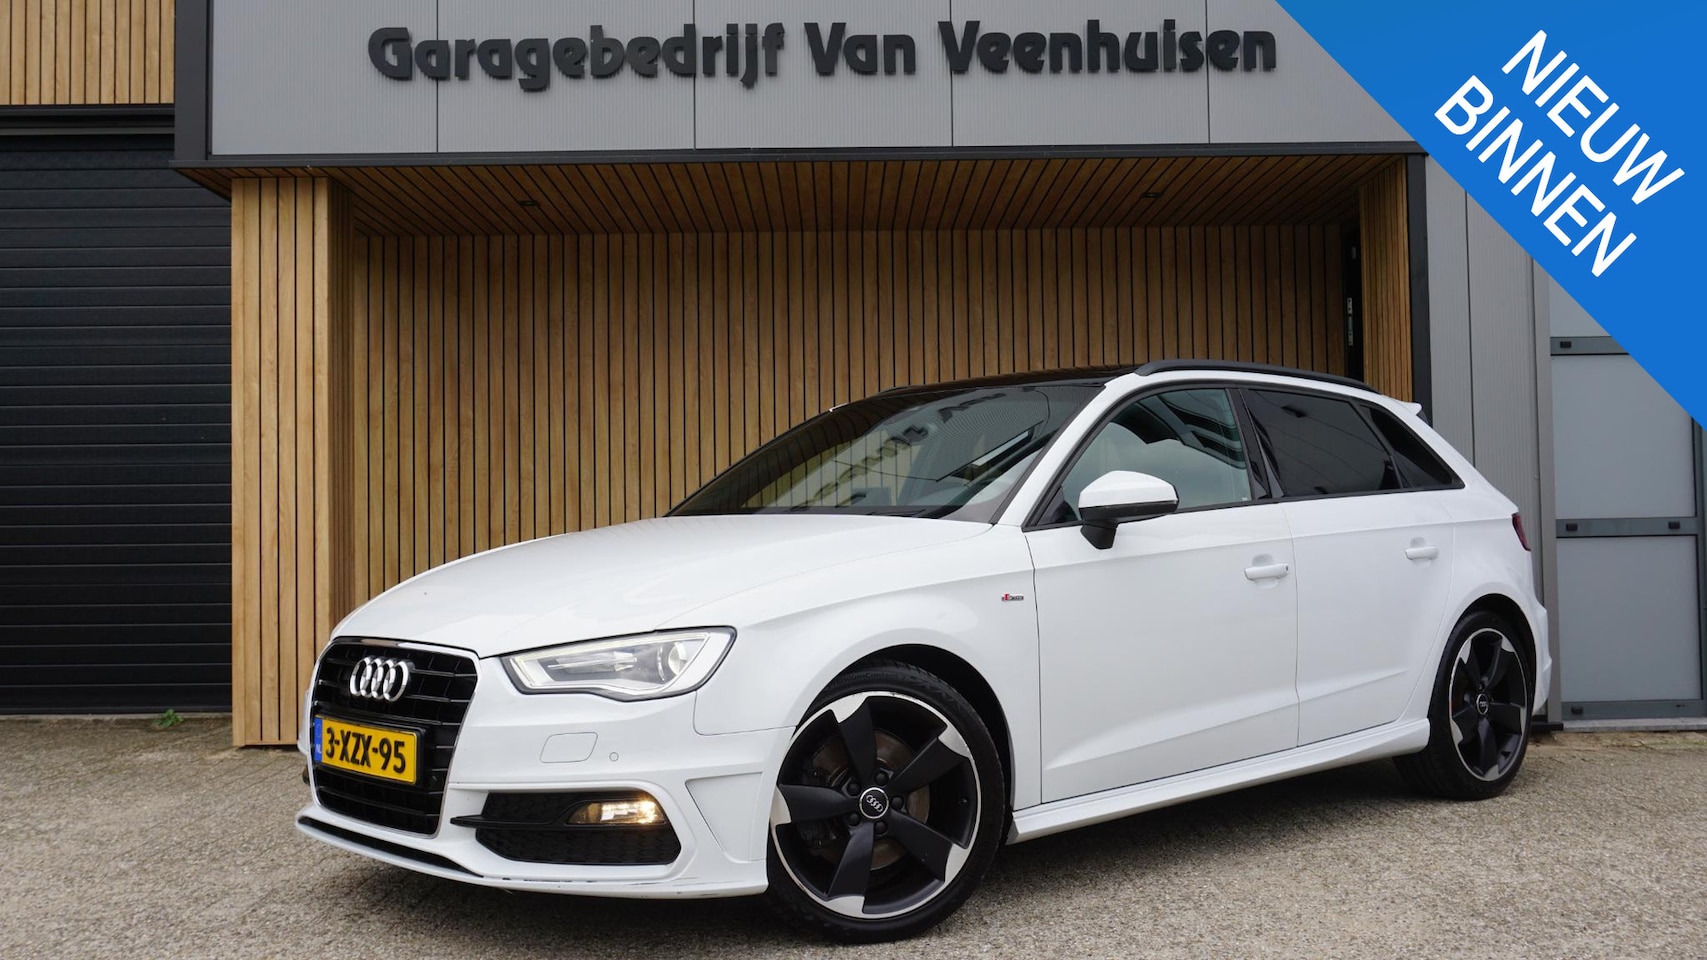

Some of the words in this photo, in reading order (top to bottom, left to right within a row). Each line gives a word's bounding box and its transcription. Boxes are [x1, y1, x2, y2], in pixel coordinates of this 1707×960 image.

[367, 22, 786, 92] Garagebedrijf
[804, 22, 916, 76] Van
[938, 19, 1277, 73] Veenhuisen
[325, 726, 407, 775] 3-XZX-95
